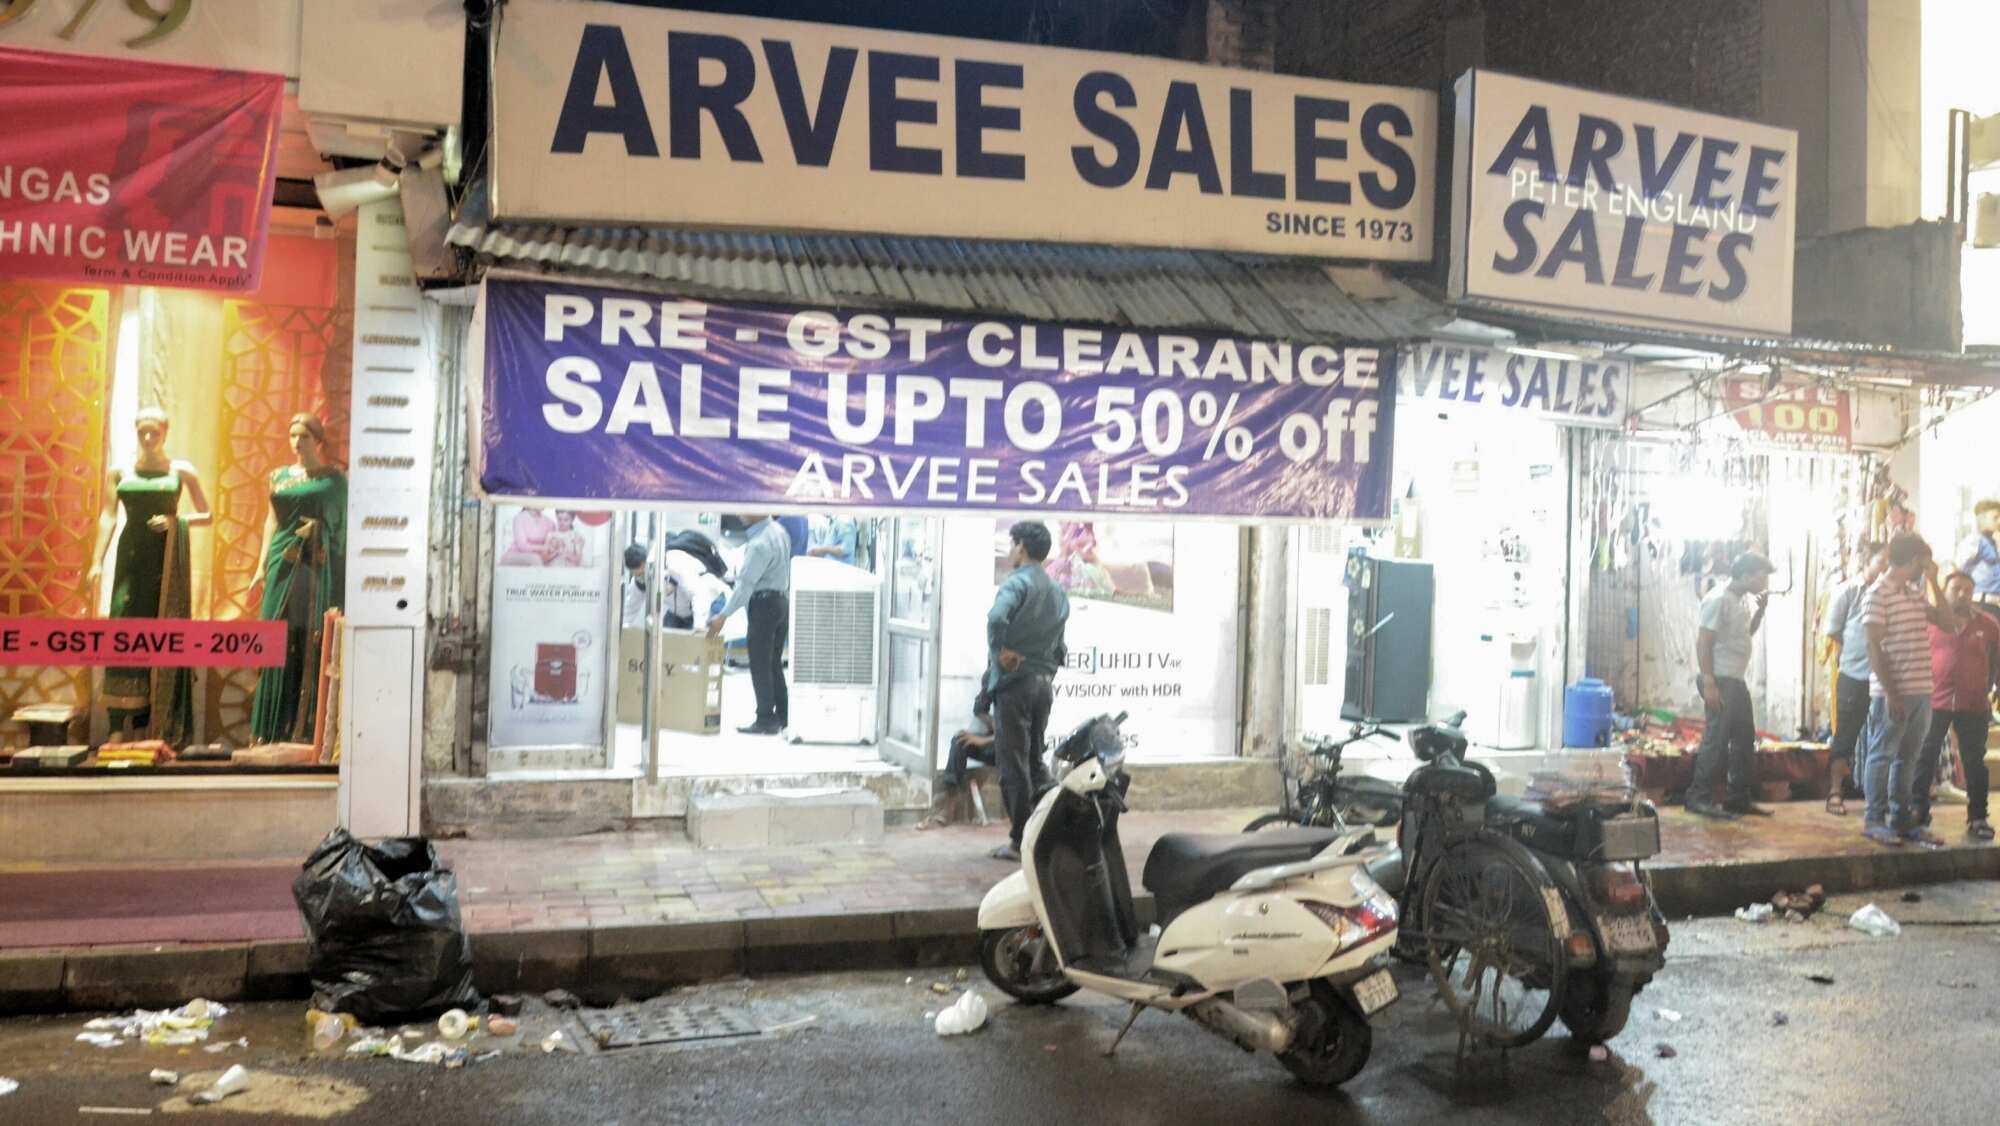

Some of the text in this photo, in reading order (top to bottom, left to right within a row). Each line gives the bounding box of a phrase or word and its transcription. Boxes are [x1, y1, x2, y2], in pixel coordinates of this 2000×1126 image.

[550, 23, 1416, 210] ARVEE SALES
[1486, 104, 1787, 219] ARVEE
[1266, 212, 1413, 242] SINCE 1973
[1511, 167, 1757, 234] PETER ENGLAND
[84, 265, 115, 278] Term
[138, 268, 203, 282] Condition
[124, 228, 248, 268] WEAR
[1492, 198, 1753, 302] SALES
[544, 294, 708, 349] PRE
[787, 310, 942, 361] GST
[967, 322, 1380, 388] CLEARANCE
[542, 356, 791, 440] SALE
[827, 371, 1062, 452] UPTO
[1092, 386, 1253, 463] 50%
[1502, 353, 1620, 418] SALES
[785, 452, 1189, 508] ARVEE SALES
[47, 631, 104, 651] GST
[113, 632, 184, 653] SAVE
[210, 633, 263, 655] 20%
[1100, 652, 1141, 669] UHD
[1121, 682, 1148, 697] with
[1153, 682, 1181, 697] HDR
